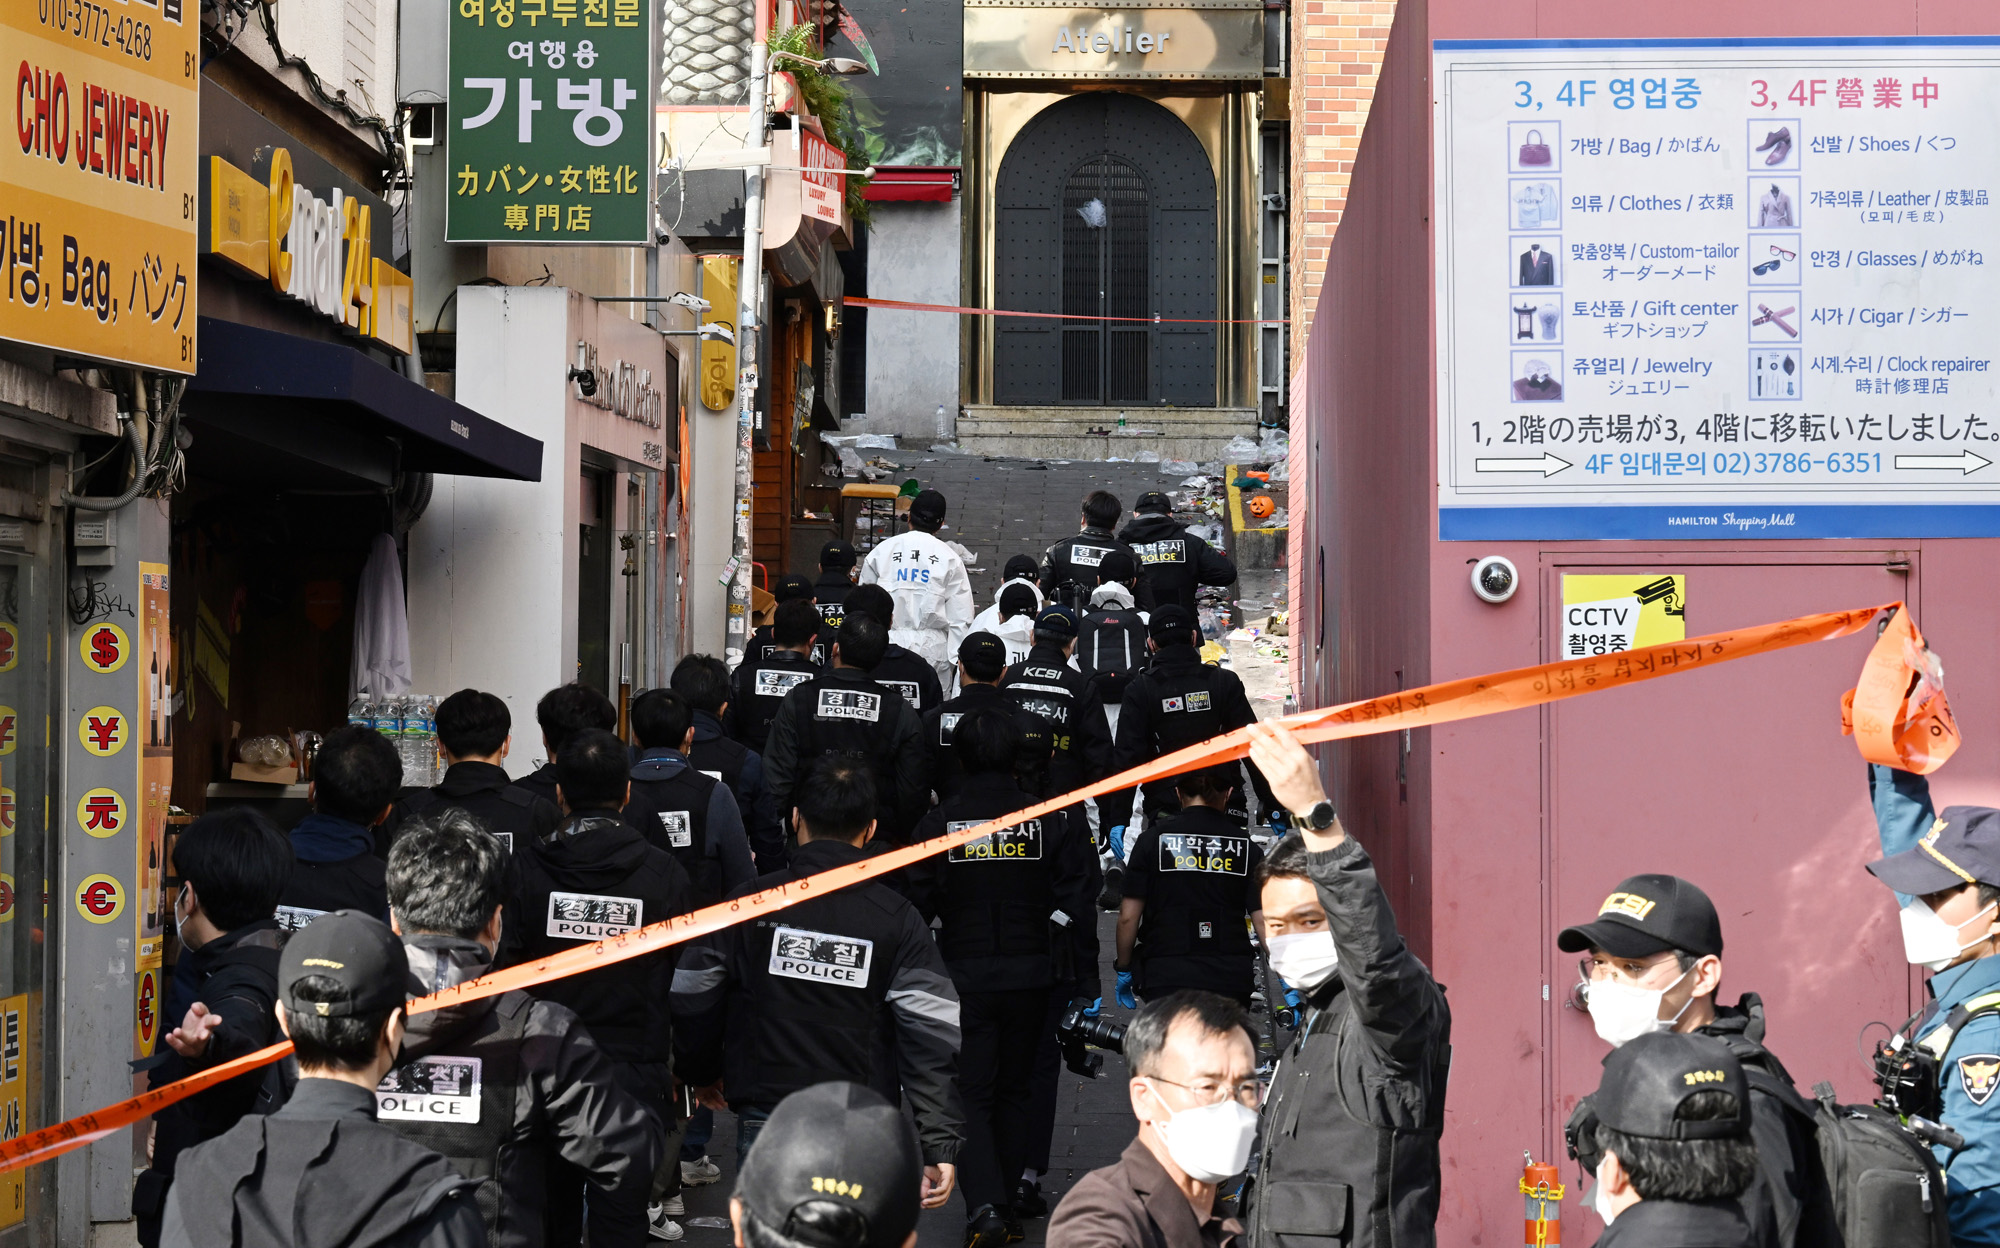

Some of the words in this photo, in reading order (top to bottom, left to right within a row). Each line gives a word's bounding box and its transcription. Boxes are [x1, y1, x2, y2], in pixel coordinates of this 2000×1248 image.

[38, 0, 152, 62] 010-3772-4268
[1052, 26, 1170, 53] Atelier
[507, 39, 599, 70] 여행용
[184, 51, 196, 80] B1
[1514, 80, 1544, 112] 3,
[1555, 79, 1597, 108] 4F
[1608, 77, 1702, 111] 영업중
[1750, 79, 1778, 111] 3,
[1787, 79, 1828, 107] 4F
[462, 77, 637, 147] 가방
[17, 60, 69, 164] CHO
[75, 81, 169, 191] JEWERY
[1570, 137, 1604, 156] 가방
[1619, 138, 1651, 158] Bag
[1668, 135, 1721, 153] かばん
[1809, 135, 1843, 154] 신발
[1859, 135, 1911, 152] Shoes
[1926, 135, 1957, 152] くつ
[806, 137, 826, 187] 108
[457, 163, 639, 198] カバン・女性化
[808, 187, 827, 202] LUXURY
[1570, 194, 1604, 213] 의류
[1619, 194, 1682, 211] Clothes
[1698, 193, 1734, 211] 衣類
[1810, 190, 1865, 207] 가죽의류
[1877, 189, 1932, 206] Leather
[1944, 189, 1989, 207] 皮製品
[183, 193, 195, 221] B1
[817, 204, 835, 218] LOUNGE
[1571, 242, 1627, 261] 맞춤양복
[1639, 242, 1740, 259] Custom-tailor
[1810, 250, 1841, 269] 안경
[1856, 249, 1918, 267] Glasses
[1932, 249, 1984, 266] めがね
[63, 234, 118, 325] Bag,
[1602, 264, 1716, 282] オーダーメード
[1571, 300, 1626, 318] 토산품
[1643, 299, 1677, 317] Gift
[1680, 301, 1740, 316] center
[1810, 307, 1844, 326] 시가
[1859, 307, 1904, 328] Cigar
[1920, 306, 1969, 323] シガー
[1602, 320, 1709, 339] ギフトショップ
[181, 335, 193, 363] B1
[709, 356, 727, 394] 108
[1572, 357, 1625, 376] 쥬얼리
[1643, 356, 1713, 378] Jewelry
[1887, 355, 1929, 372] Clock
[1931, 356, 1991, 376] repairer
[614, 359, 662, 429] Collection
[1608, 379, 1690, 396] ジュエリー
[1855, 376, 1951, 395] 時計修理店
[1471, 420, 1492, 447] 1,
[1584, 453, 1614, 475] 4F
[1619, 451, 1706, 477] 임대문의
[1712, 451, 1881, 477] 02)3786-6351
[1667, 515, 1718, 527] HAMILTON
[1721, 512, 1767, 530] Shopping
[1767, 512, 1797, 528] Mall
[892, 550, 939, 564] 국과수
[1133, 542, 1182, 555] 과학수사
[1140, 552, 1177, 562] POLICE
[1076, 557, 1099, 565] POLI
[897, 568, 931, 583] NFS
[1568, 608, 1629, 626] CCTV
[1567, 633, 1629, 656] 촬영중
[1023, 667, 1063, 680] KCSI
[762, 686, 793, 695] POLI
[827, 692, 873, 709] 경찰
[825, 706, 872, 719] POLICE
[1016, 701, 1068, 724] 학수사
[85, 796, 119, 830] 元
[964, 842, 1026, 858] POLICE
[1165, 837, 1243, 856] 과학수사
[1174, 855, 1233, 871] POLICE
[563, 899, 631, 925] 경찰
[558, 922, 631, 937] POLICE
[786, 936, 860, 967] 경찰
[781, 961, 856, 982] POLICE
[381, 1096, 462, 1115] OLICE
